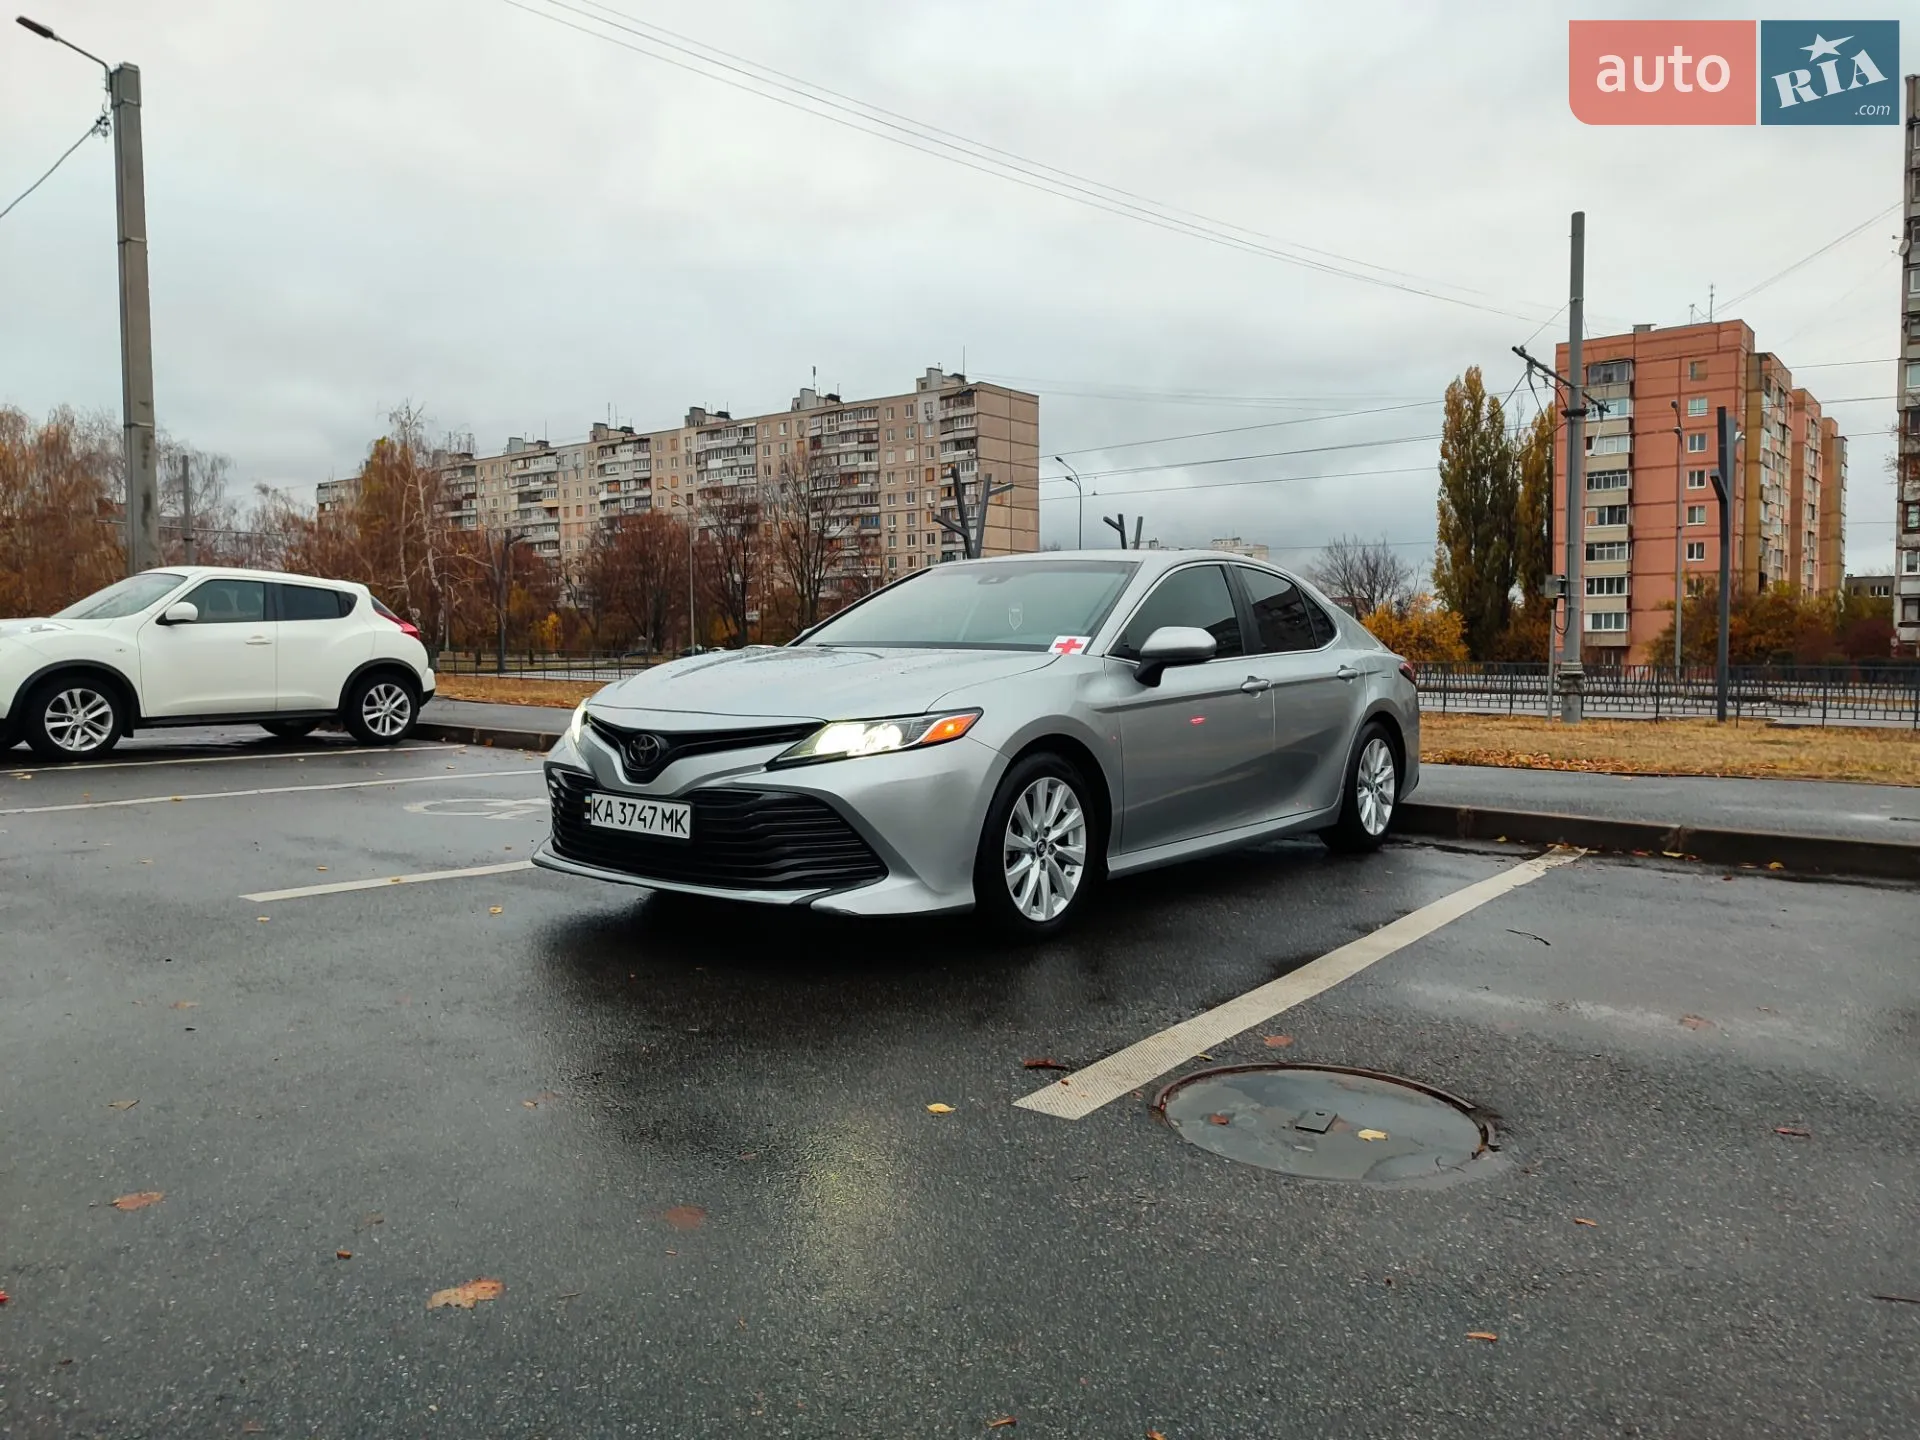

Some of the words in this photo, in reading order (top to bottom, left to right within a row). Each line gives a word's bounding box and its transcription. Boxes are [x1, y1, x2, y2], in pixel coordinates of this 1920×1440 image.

[592, 798, 614, 824] KA
[618, 802, 658, 830] 3747
[661, 807, 688, 834] MK
